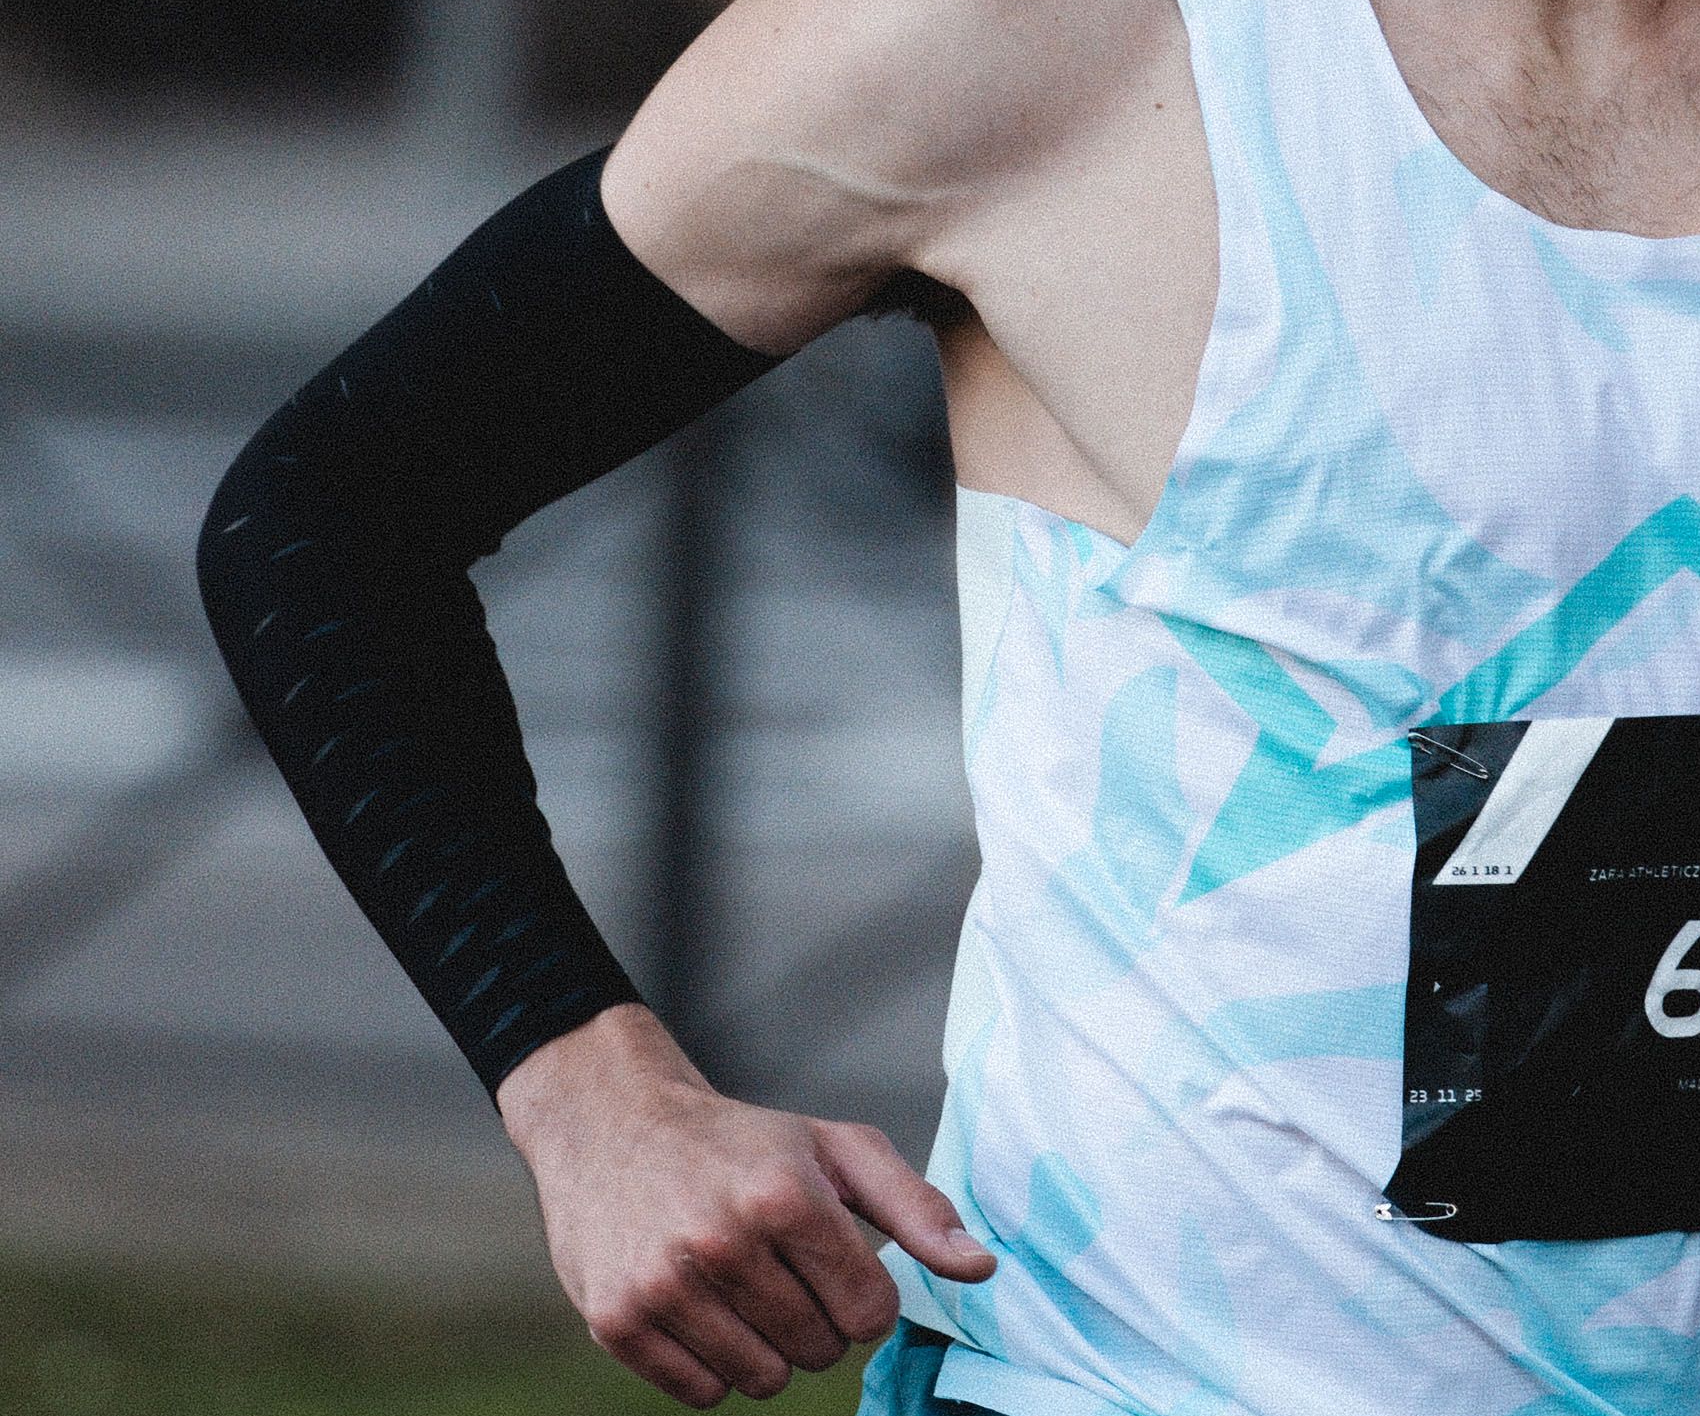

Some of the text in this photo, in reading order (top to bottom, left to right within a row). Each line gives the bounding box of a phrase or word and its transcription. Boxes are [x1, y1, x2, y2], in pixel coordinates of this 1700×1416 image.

[1452, 865, 1513, 876] 26 1 18 1
[1409, 1089, 1483, 1103] 23 11 25
